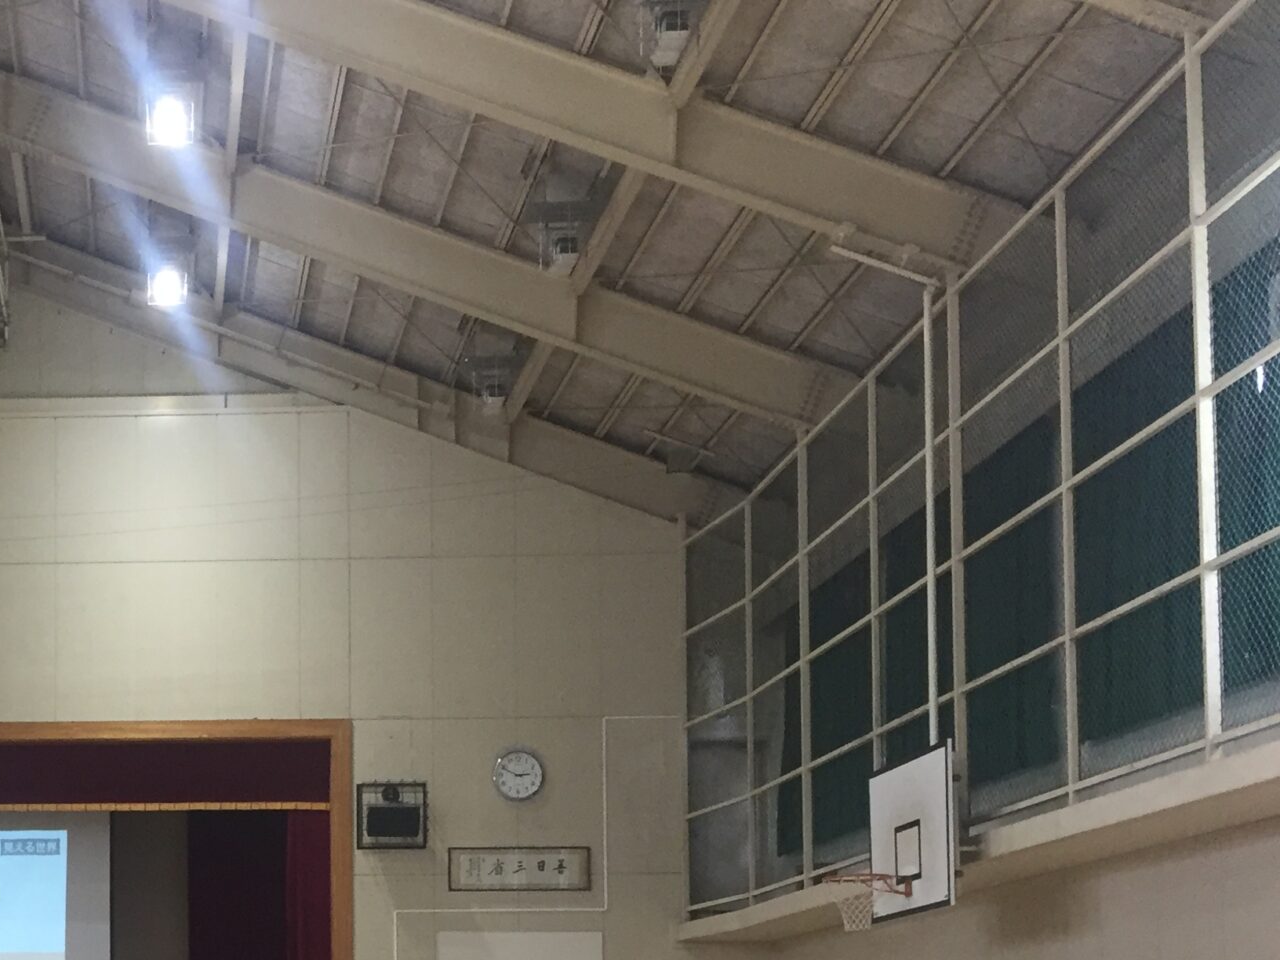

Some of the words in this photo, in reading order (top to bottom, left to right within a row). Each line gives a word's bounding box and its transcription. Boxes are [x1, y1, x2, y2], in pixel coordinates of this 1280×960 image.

[4, 840, 58, 854] 見える世界
